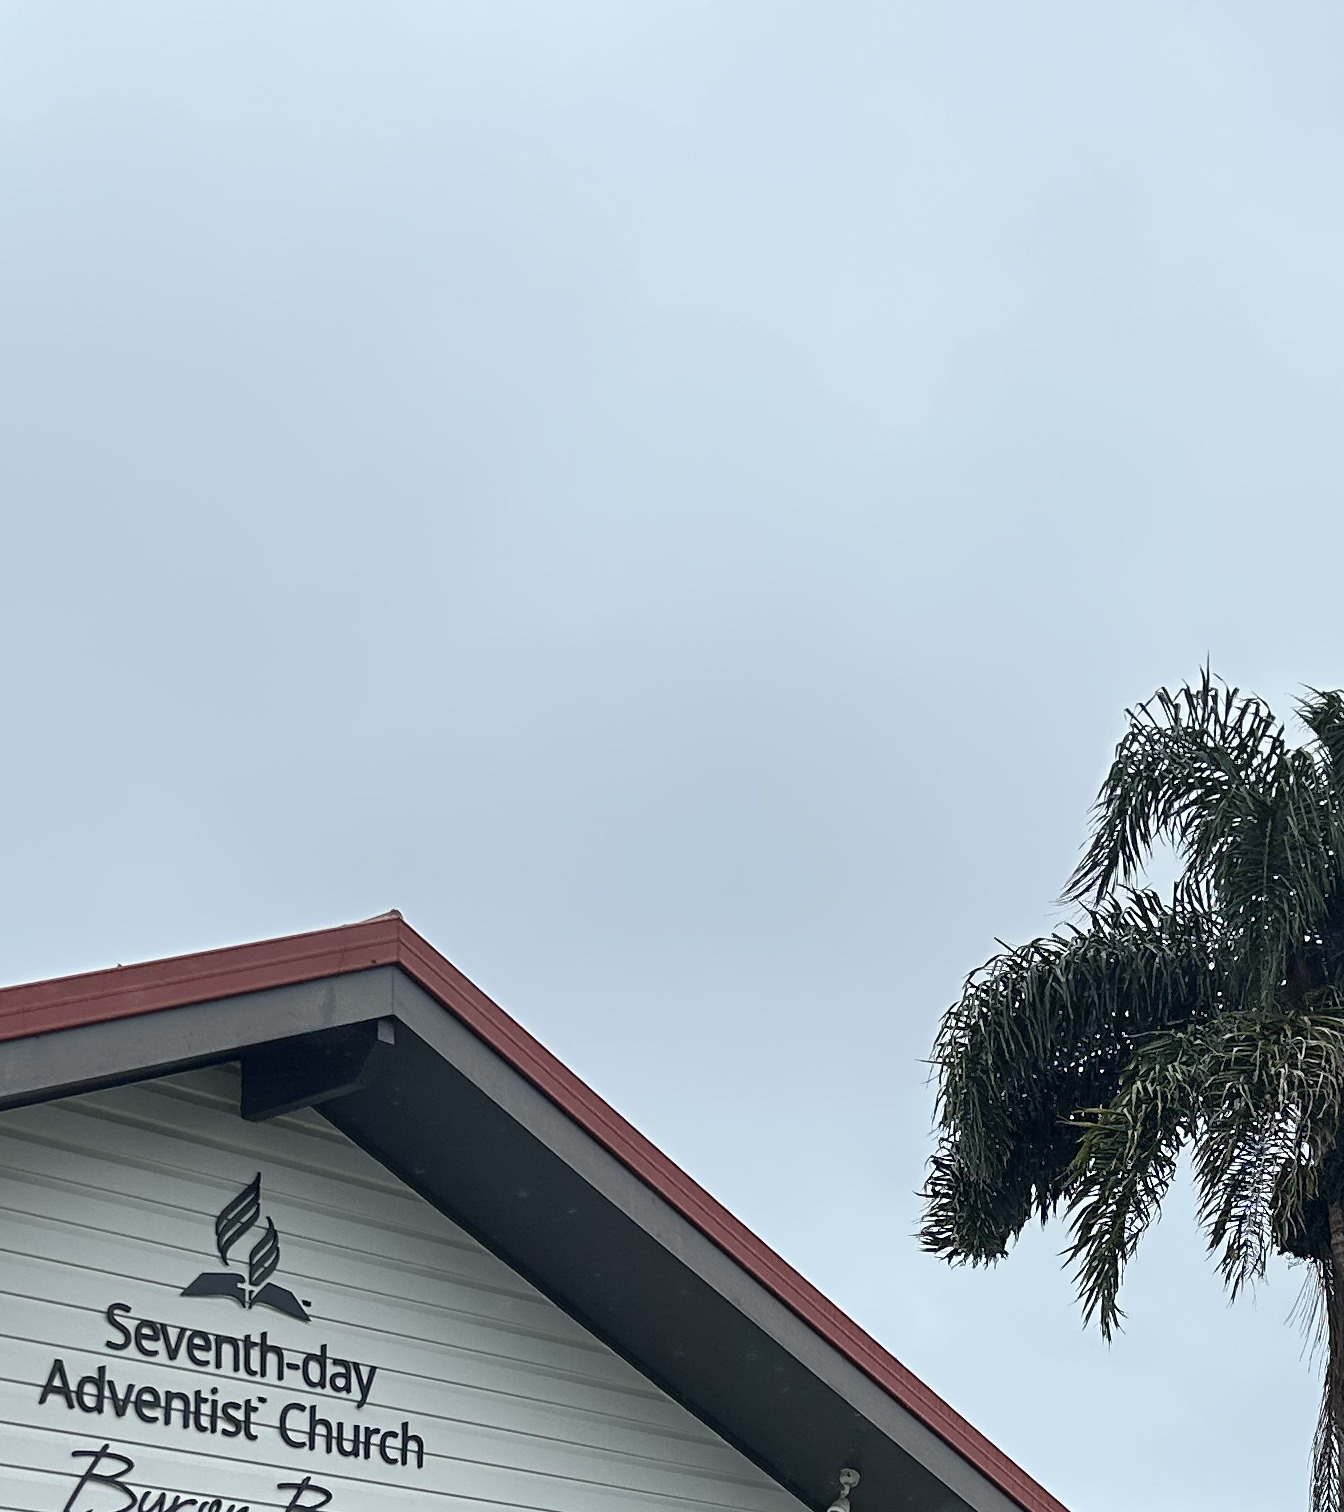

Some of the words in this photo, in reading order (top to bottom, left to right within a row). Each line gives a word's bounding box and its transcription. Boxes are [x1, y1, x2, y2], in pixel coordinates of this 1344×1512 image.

[104, 1302, 378, 1409] Seventh-day
[38, 1357, 260, 1441] Adventist
[278, 1401, 425, 1469] Church
